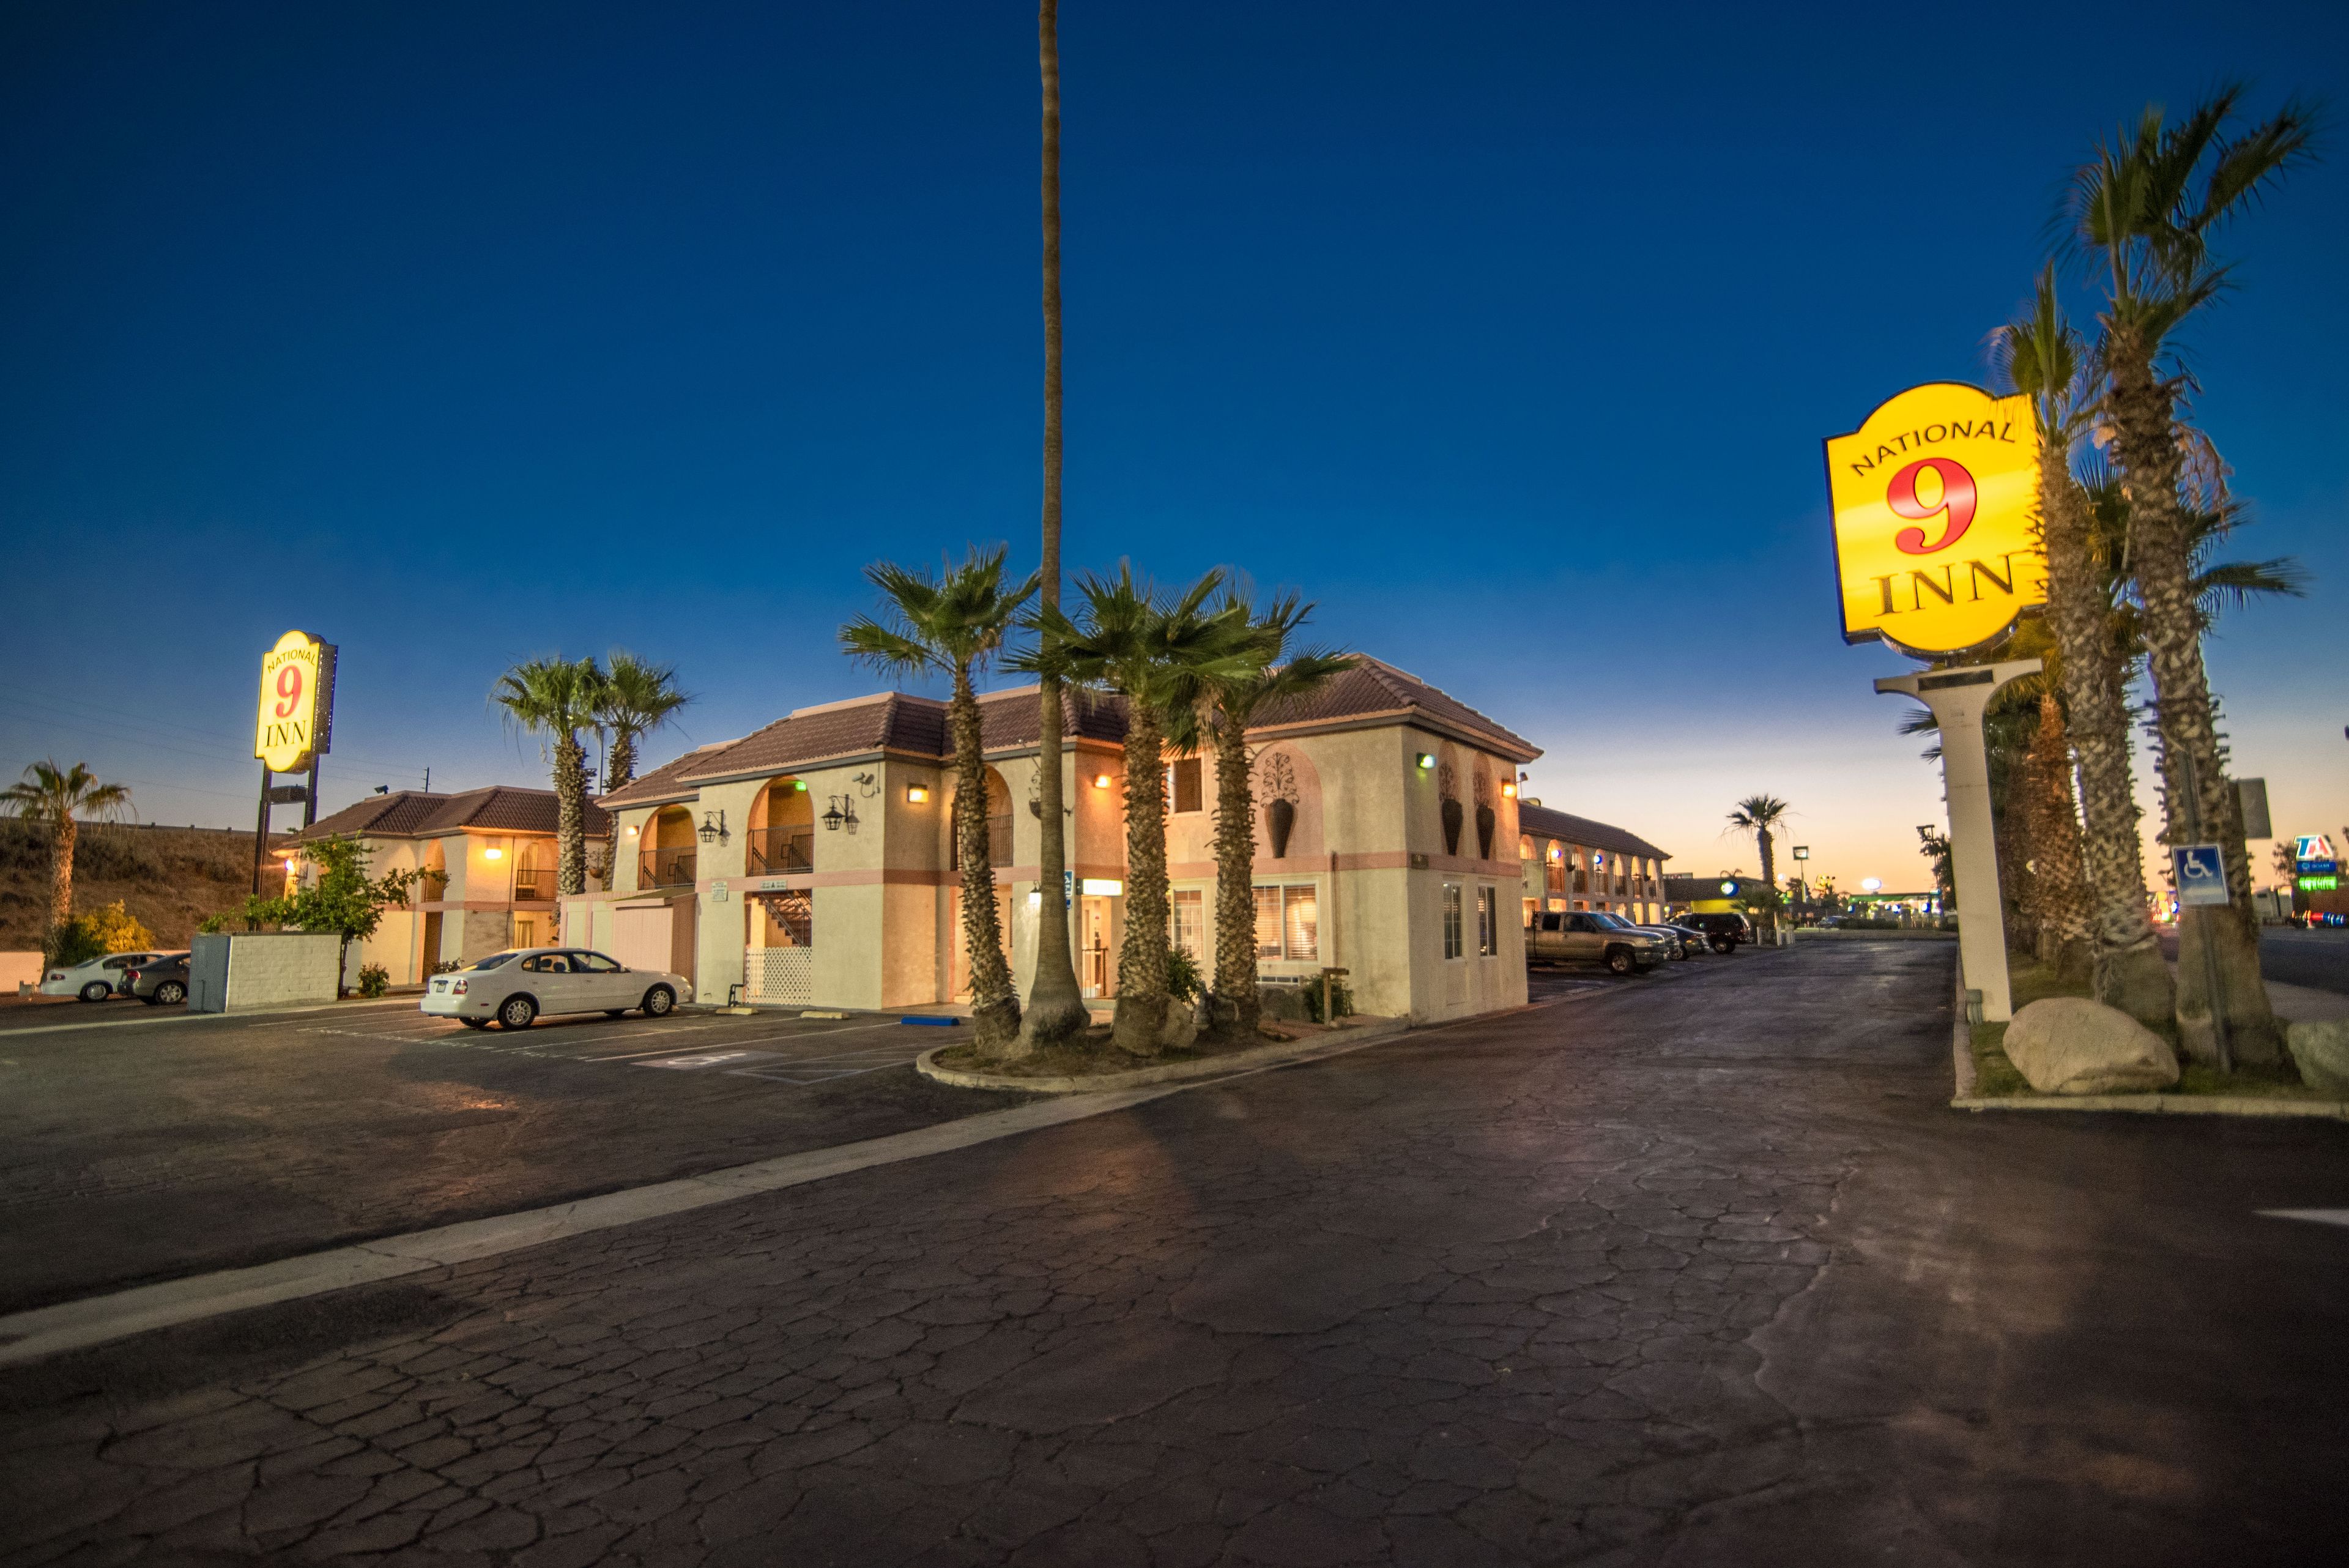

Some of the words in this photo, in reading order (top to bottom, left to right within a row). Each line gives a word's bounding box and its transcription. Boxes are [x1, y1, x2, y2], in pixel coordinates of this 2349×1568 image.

[1851, 420, 2016, 477] NATIONAL
[1887, 458, 1976, 554] 9
[1870, 554, 2017, 617] INN
[268, 649, 316, 674] NATIONAL
[276, 665, 302, 718] 9
[264, 720, 306, 748] INN
[2295, 835, 2333, 860] TA
